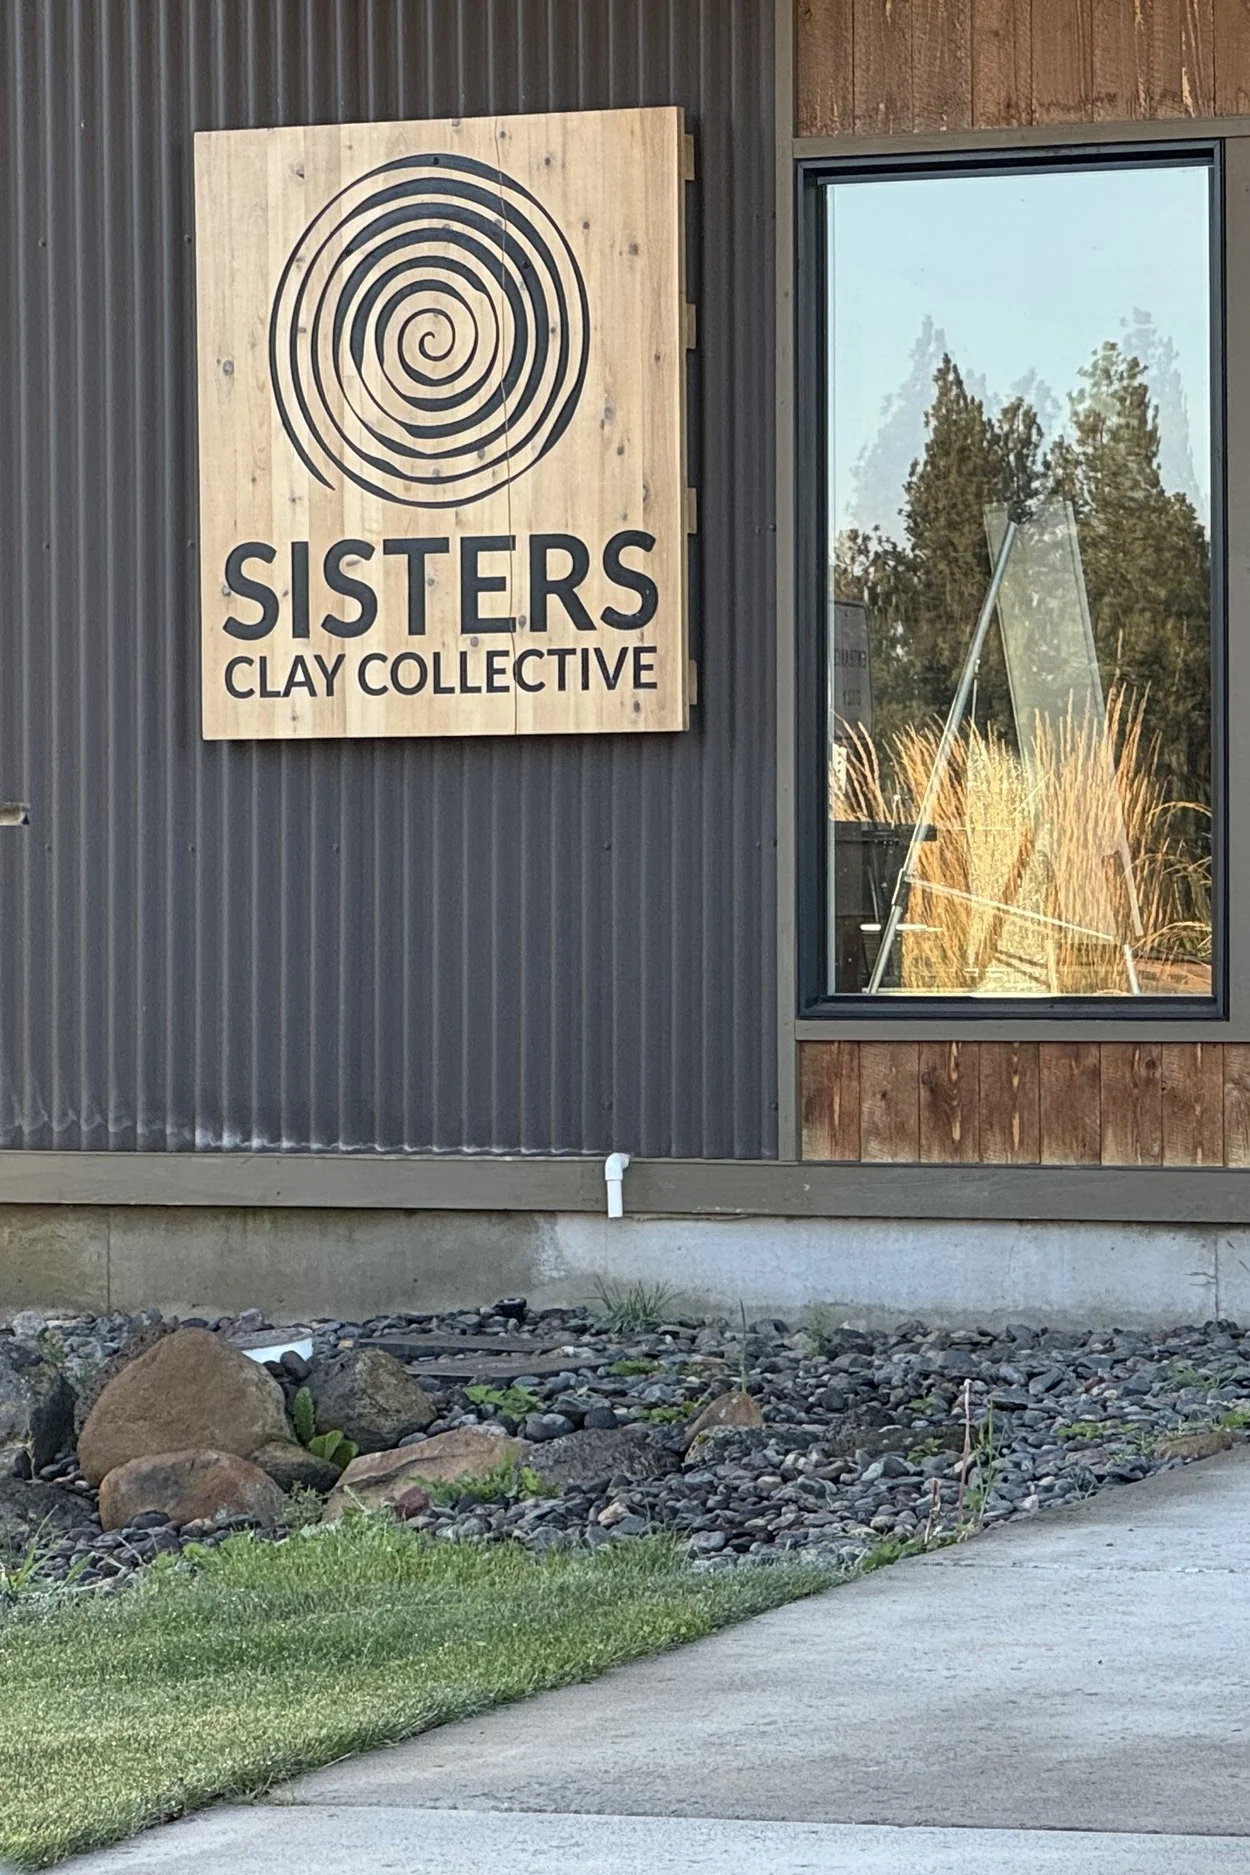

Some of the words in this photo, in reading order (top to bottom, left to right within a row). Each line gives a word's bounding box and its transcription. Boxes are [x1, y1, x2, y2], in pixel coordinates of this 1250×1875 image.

[222, 529, 660, 641] SISTERS
[224, 653, 346, 699] CLAY
[357, 645, 658, 696] COLLECTIVE
